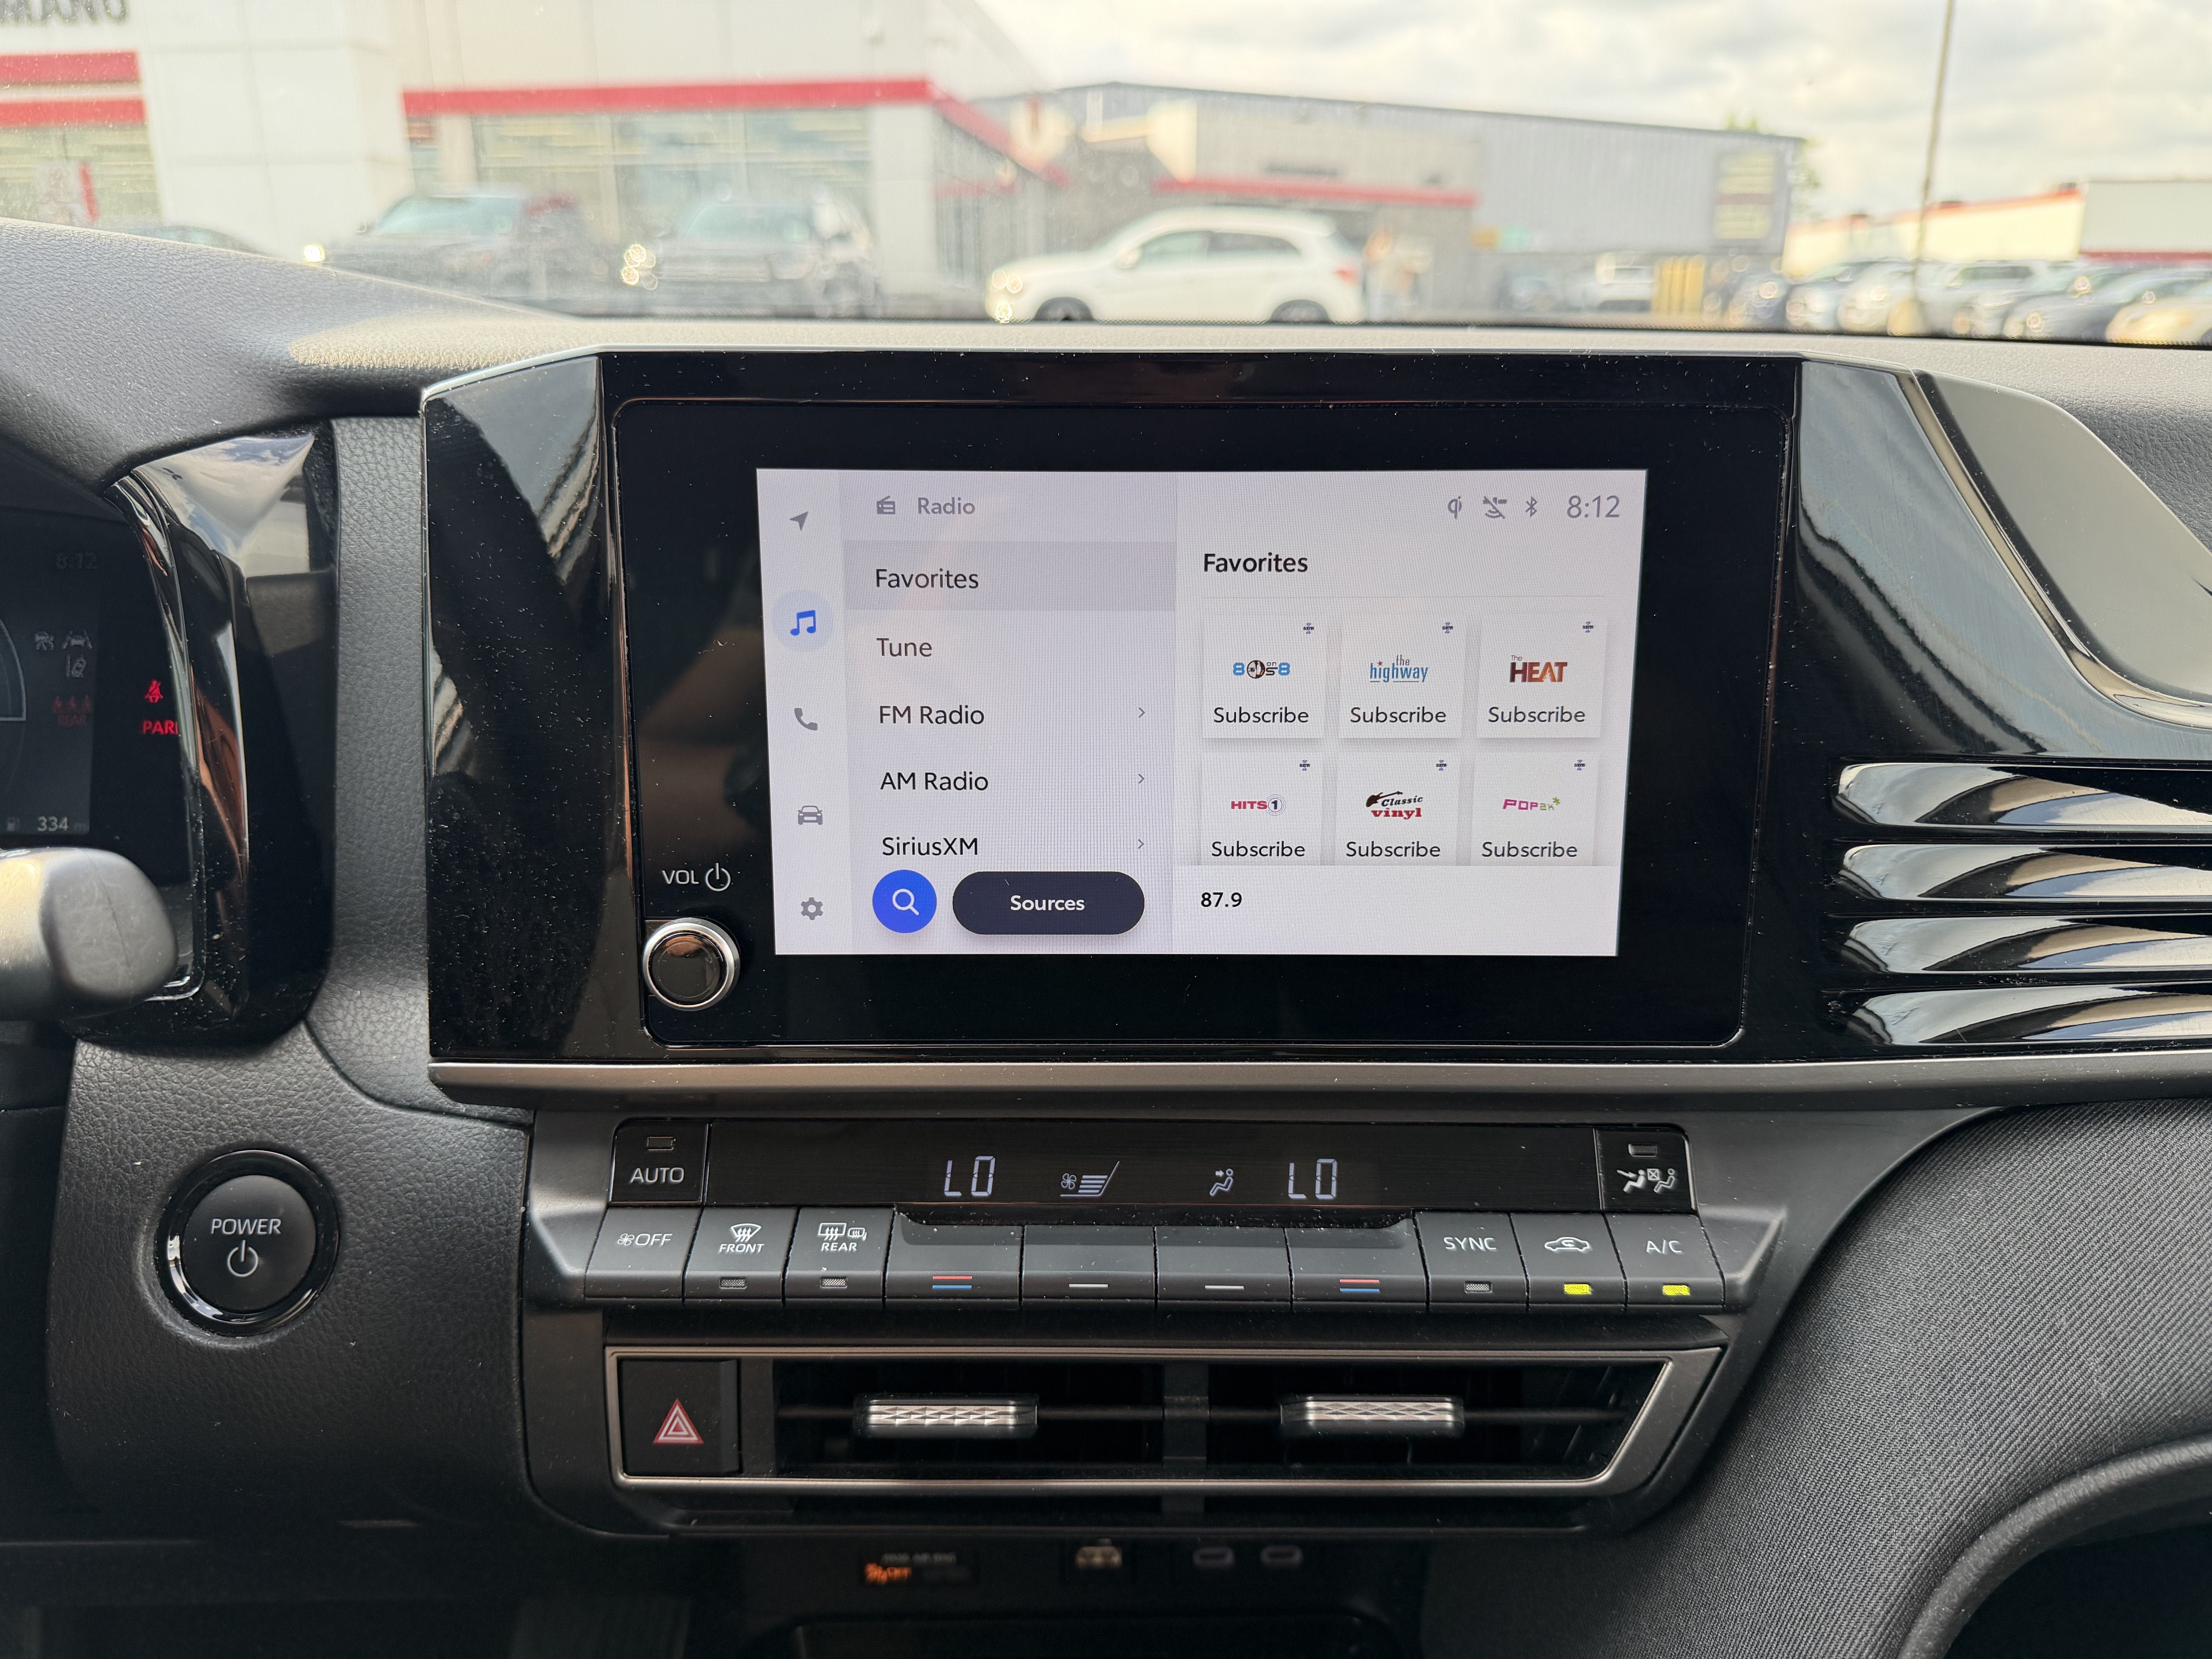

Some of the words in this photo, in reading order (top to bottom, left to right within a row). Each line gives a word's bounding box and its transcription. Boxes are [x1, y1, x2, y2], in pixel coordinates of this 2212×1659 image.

[918, 497, 975, 515] Radio
[1567, 495, 1620, 519] 8:12
[1204, 552, 1308, 573] Favorites
[876, 568, 979, 589] Favorites
[877, 637, 933, 657] Tune
[1396, 654, 1410, 666] the
[1370, 661, 1428, 683] highway
[1509, 662, 1568, 682] HEAT
[879, 706, 911, 724] FM
[920, 704, 984, 725] Radio
[1214, 706, 1309, 723] Subscribe
[1350, 706, 1446, 723] Subscribe
[1488, 706, 1585, 723] Subscribe
[880, 772, 916, 790] AM
[925, 771, 989, 791] Radio
[1231, 800, 1267, 809] HITS
[1271, 800, 1278, 810] 1
[1381, 795, 1423, 807] Classic
[1371, 808, 1422, 820] vinyl
[37, 816, 69, 831] 334
[882, 836, 978, 856] SiriusXM
[1212, 840, 1305, 857] Subscribe
[1346, 841, 1441, 857] Subscribe
[1482, 841, 1578, 857] Subscribe
[662, 870, 699, 884] VOL
[1010, 895, 1085, 911] Sources
[1200, 892, 1242, 907] 87.9
[630, 1167, 684, 1184] AUTO
[211, 1218, 281, 1235] POWER
[635, 1233, 672, 1247] OFF
[718, 1243, 764, 1253] FRONT
[821, 1242, 857, 1252] REAR
[1444, 1237, 1496, 1251] SYNC
[1646, 1239, 1682, 1254] A/C
